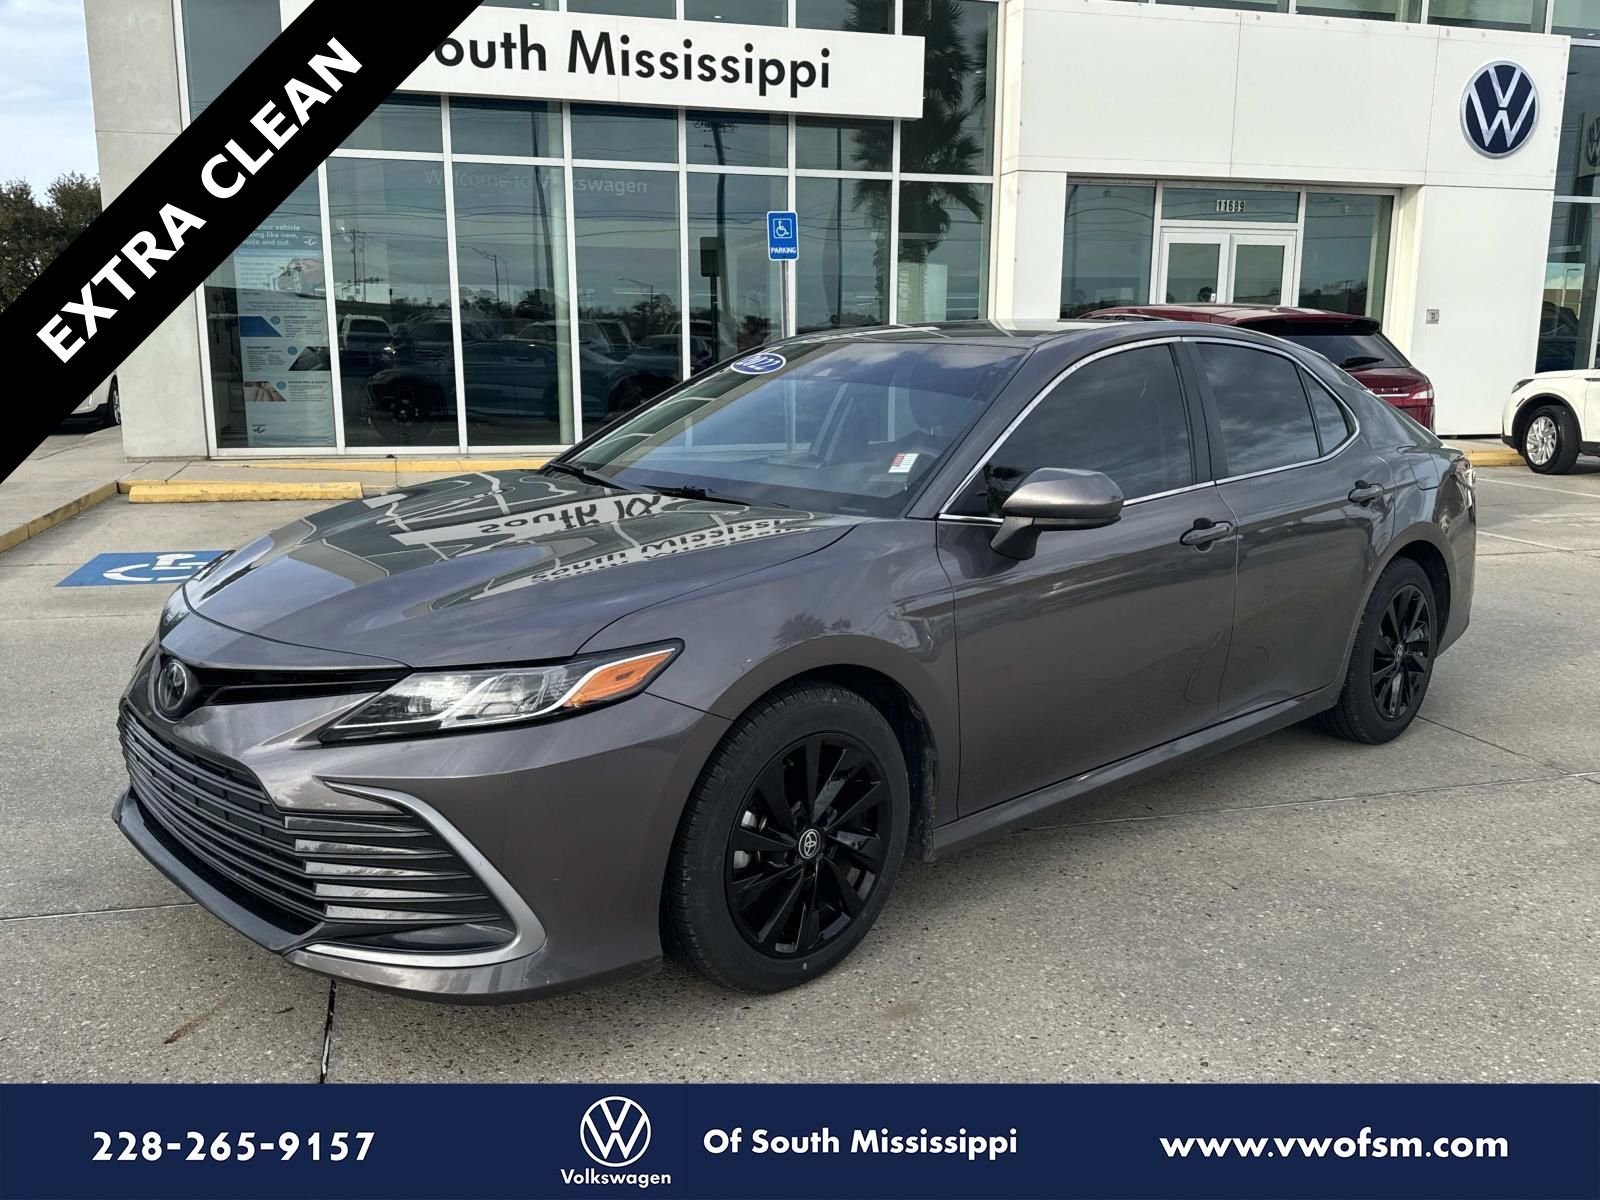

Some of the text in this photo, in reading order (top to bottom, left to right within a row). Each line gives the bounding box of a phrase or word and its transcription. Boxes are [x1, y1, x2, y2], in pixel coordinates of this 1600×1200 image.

[434, 24, 831, 99] outh Mississippi
[424, 168, 510, 189] Wlcome
[541, 174, 648, 196] Vswagen
[1216, 200, 1245, 212] 11689
